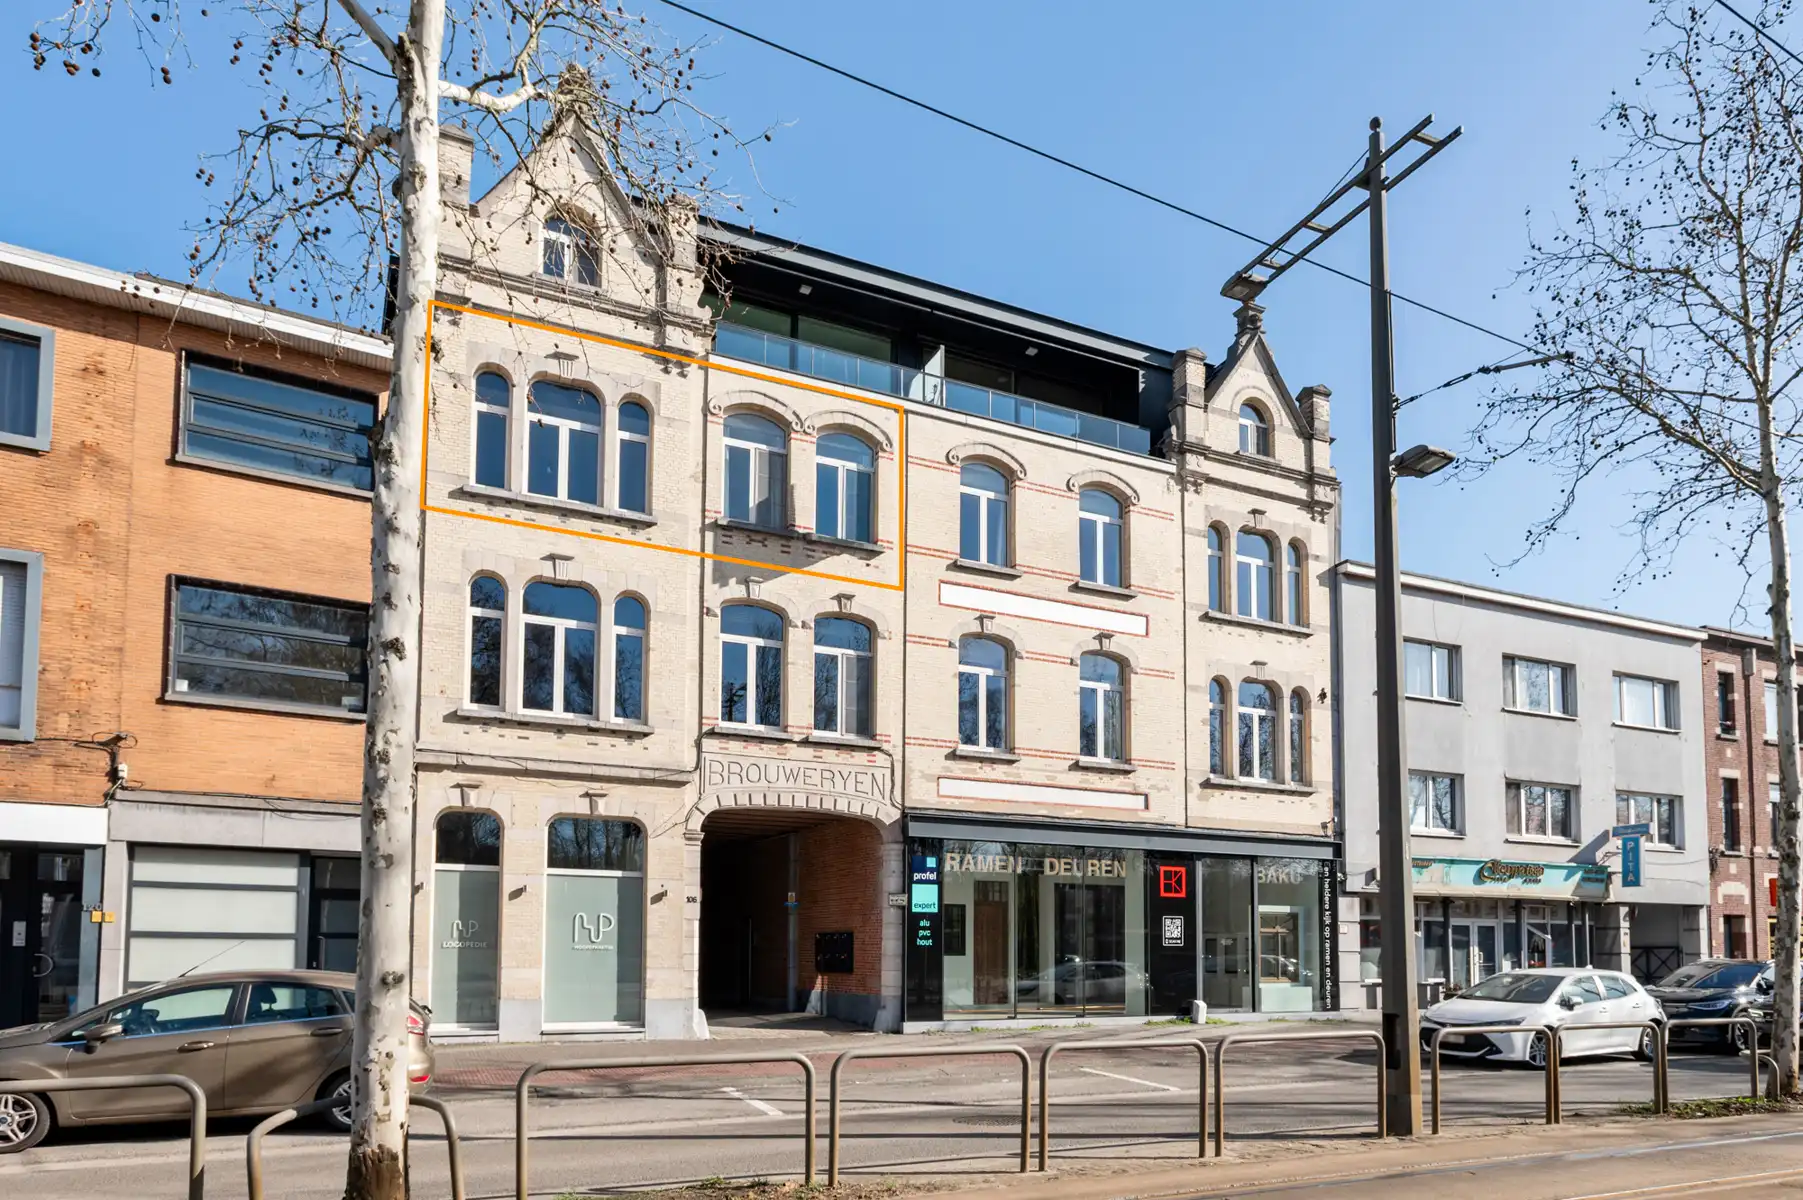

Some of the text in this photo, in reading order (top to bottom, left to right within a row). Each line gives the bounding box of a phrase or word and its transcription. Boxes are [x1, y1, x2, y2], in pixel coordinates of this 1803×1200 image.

[708, 759, 886, 800] BROUWERYEN
[944, 852, 1022, 873] RAMEN
[1626, 841, 1636, 882] PITA
[913, 872, 937, 881] profel
[1323, 878, 1332, 910] heldere
[913, 901, 937, 910] expert
[919, 919, 931, 927] alu
[918, 930, 931, 938] pvc
[1324, 927, 1332, 939] op
[916, 938, 933, 946] hout
[1324, 940, 1332, 966] ramen
[1325, 967, 1332, 978] en
[1325, 979, 1334, 1009] deuren
